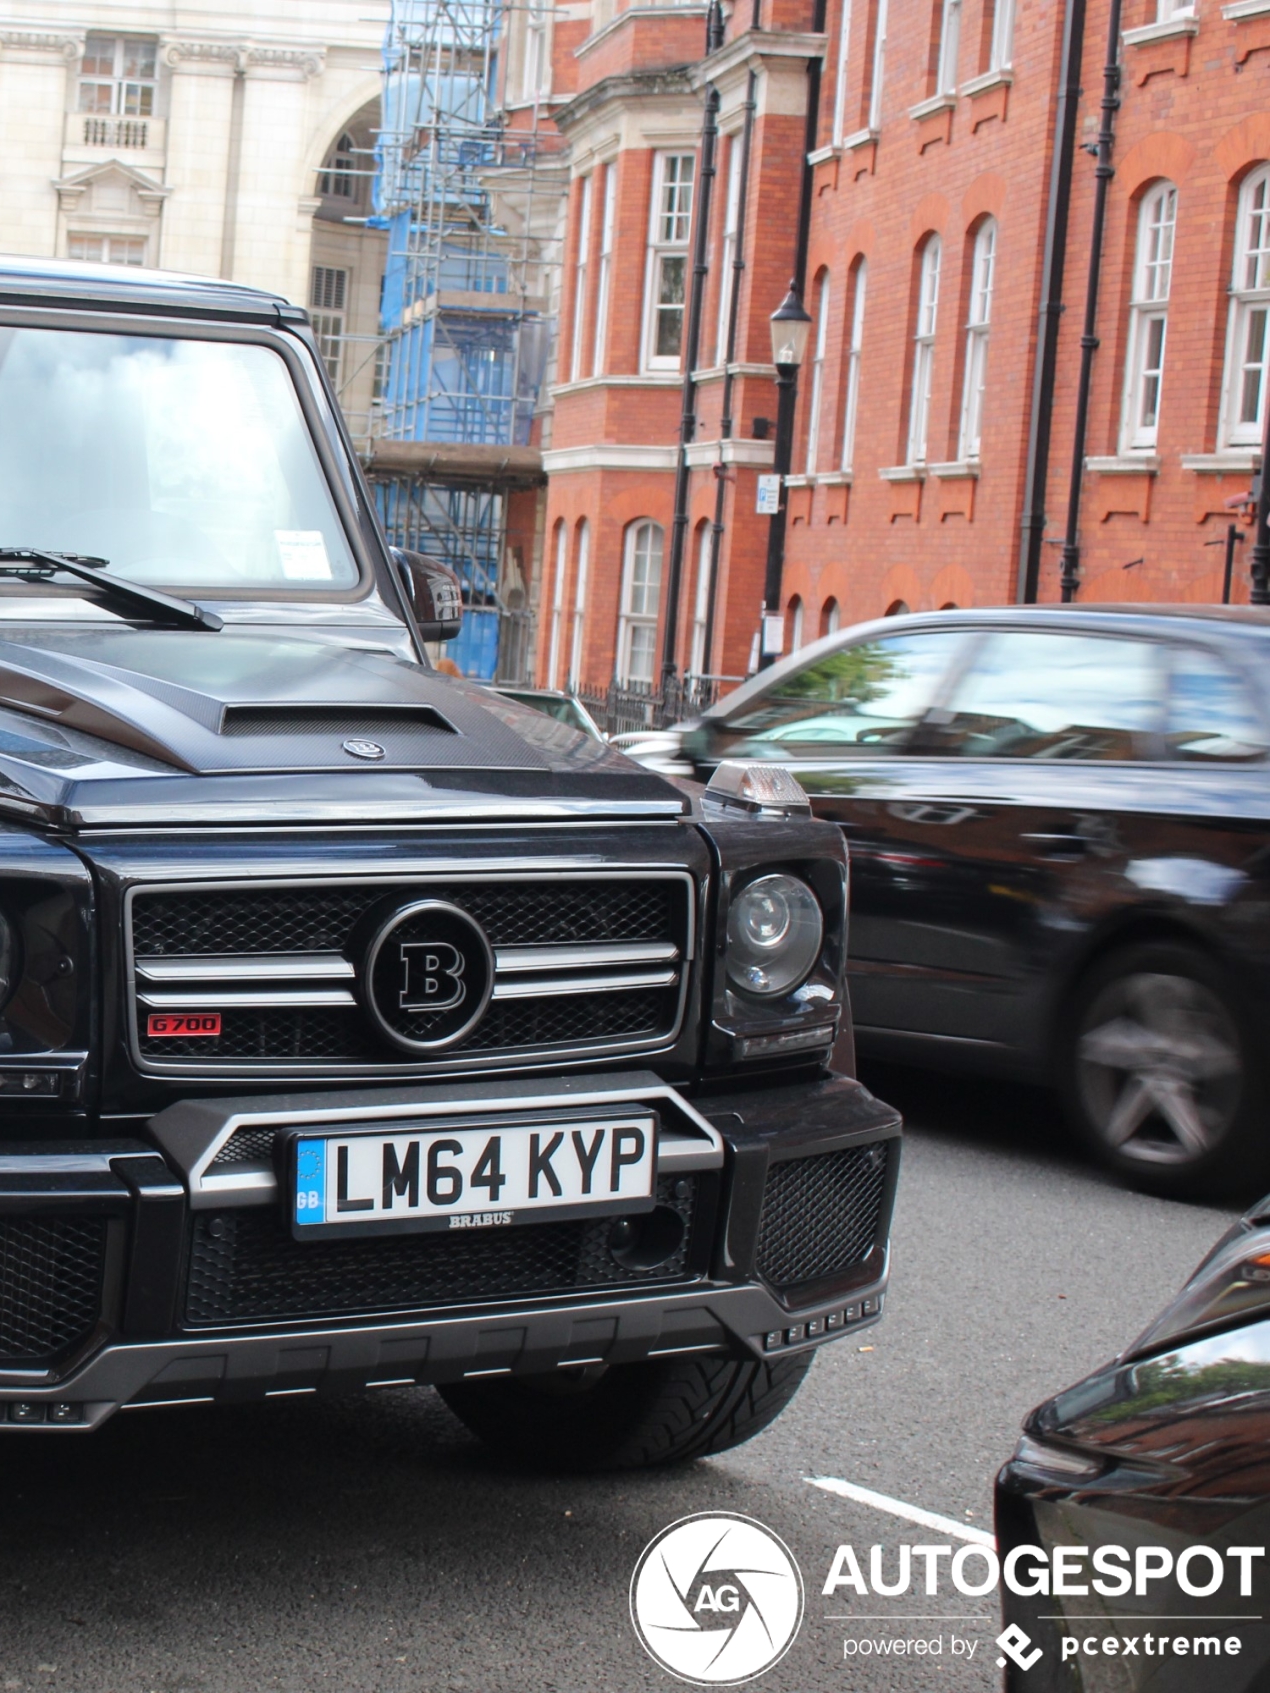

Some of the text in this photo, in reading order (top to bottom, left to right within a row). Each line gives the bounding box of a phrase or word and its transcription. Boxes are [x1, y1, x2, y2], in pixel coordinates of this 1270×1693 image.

[399, 942, 467, 1013] B
[336, 1126, 646, 1213] LM64 KYP
[297, 1190, 319, 1209] GB
[449, 1211, 513, 1229] BRABUS
